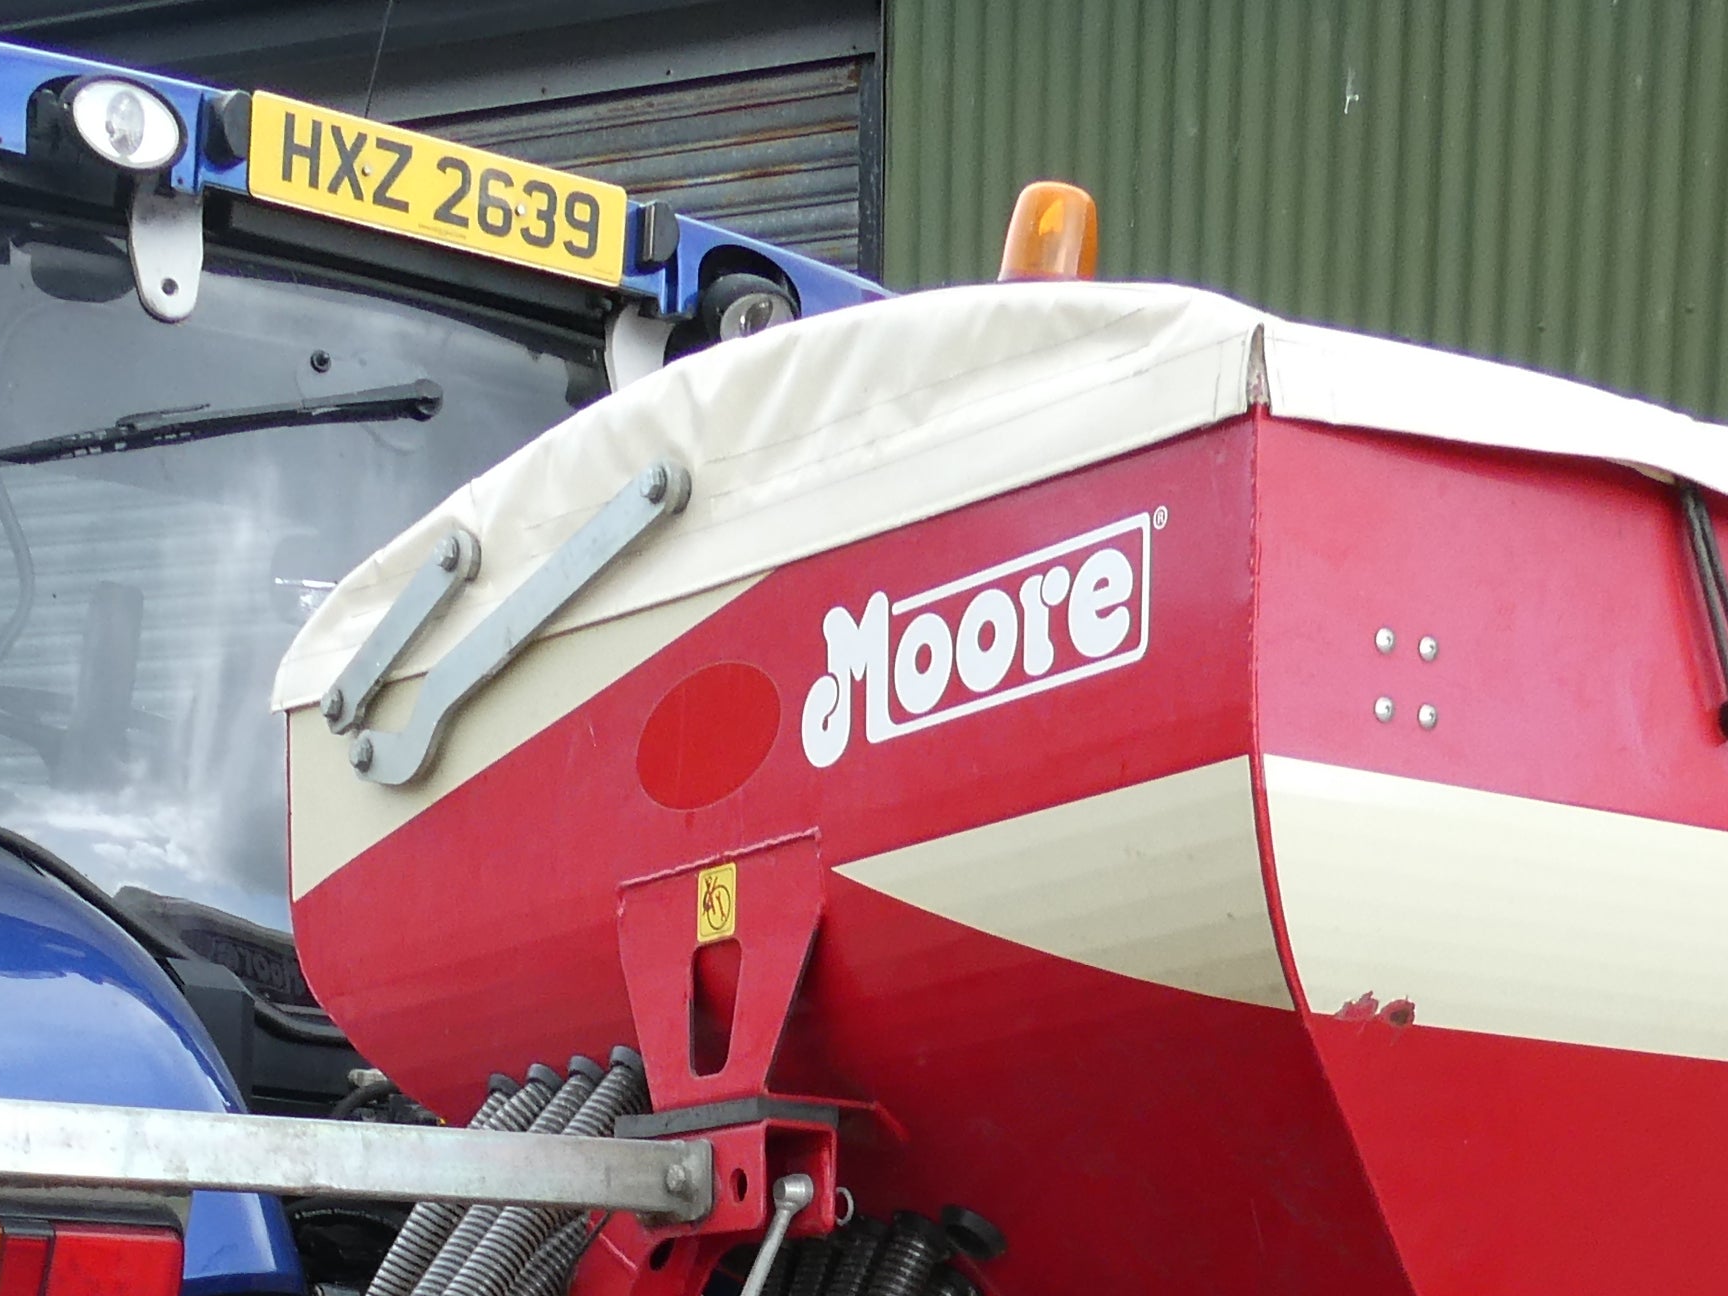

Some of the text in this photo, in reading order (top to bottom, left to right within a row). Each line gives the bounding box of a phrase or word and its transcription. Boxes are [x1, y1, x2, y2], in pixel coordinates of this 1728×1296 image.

[281, 111, 601, 260] HXZ 2639
[801, 547, 1134, 768] Moore
